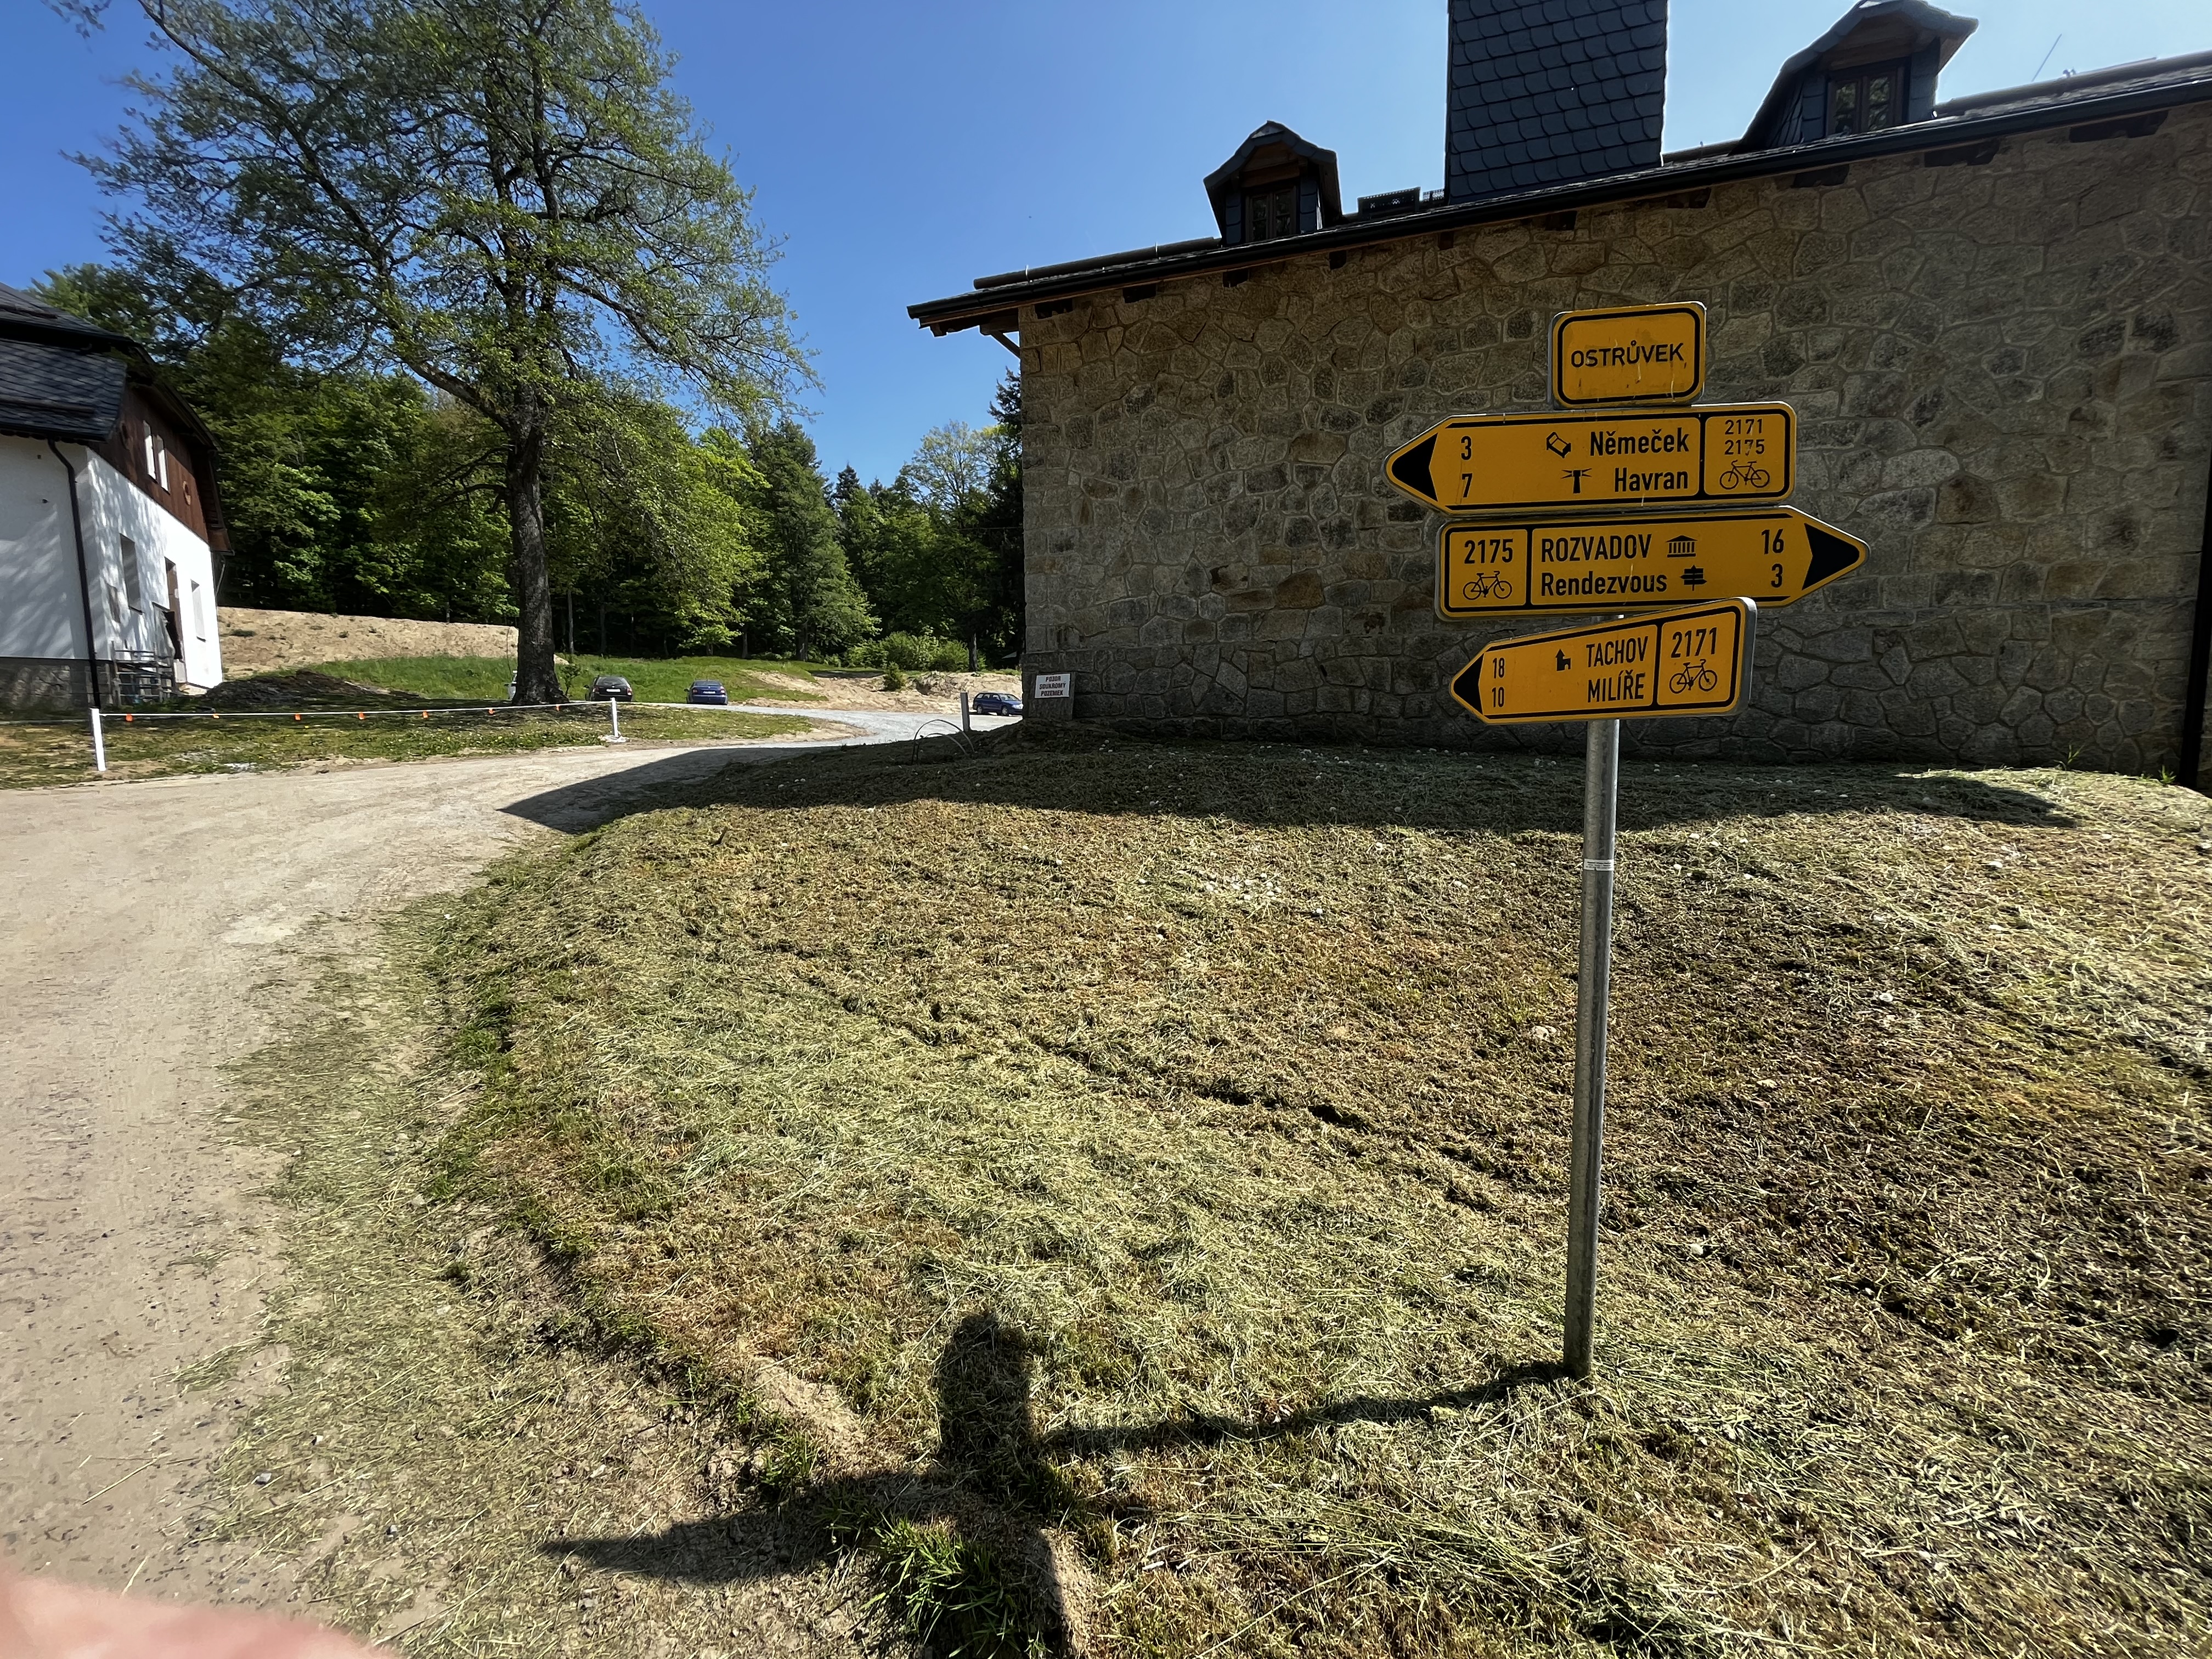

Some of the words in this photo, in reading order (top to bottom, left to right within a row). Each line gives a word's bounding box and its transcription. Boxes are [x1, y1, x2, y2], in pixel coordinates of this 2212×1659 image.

[1571, 340, 1684, 368] OSTRŮVEK
[1725, 419, 1763, 435] 2171
[1461, 436, 1472, 460] 3
[1590, 427, 1689, 456] Němeček
[1725, 439, 1765, 455] 2175
[1462, 473, 1472, 498] 7
[1615, 467, 1689, 493] Havran
[1464, 539, 1513, 564] 2175
[1541, 534, 1652, 562] ROZVADOV
[1761, 528, 1784, 555] 16
[1541, 571, 1667, 596] Rendezvous
[1770, 563, 1783, 588] 3
[1492, 657, 1505, 679] 18
[1586, 636, 1649, 668] TACHOV
[1671, 628, 1718, 658] 2171
[1492, 687, 1504, 708] 10
[1587, 670, 1645, 703] MILÍŘE
